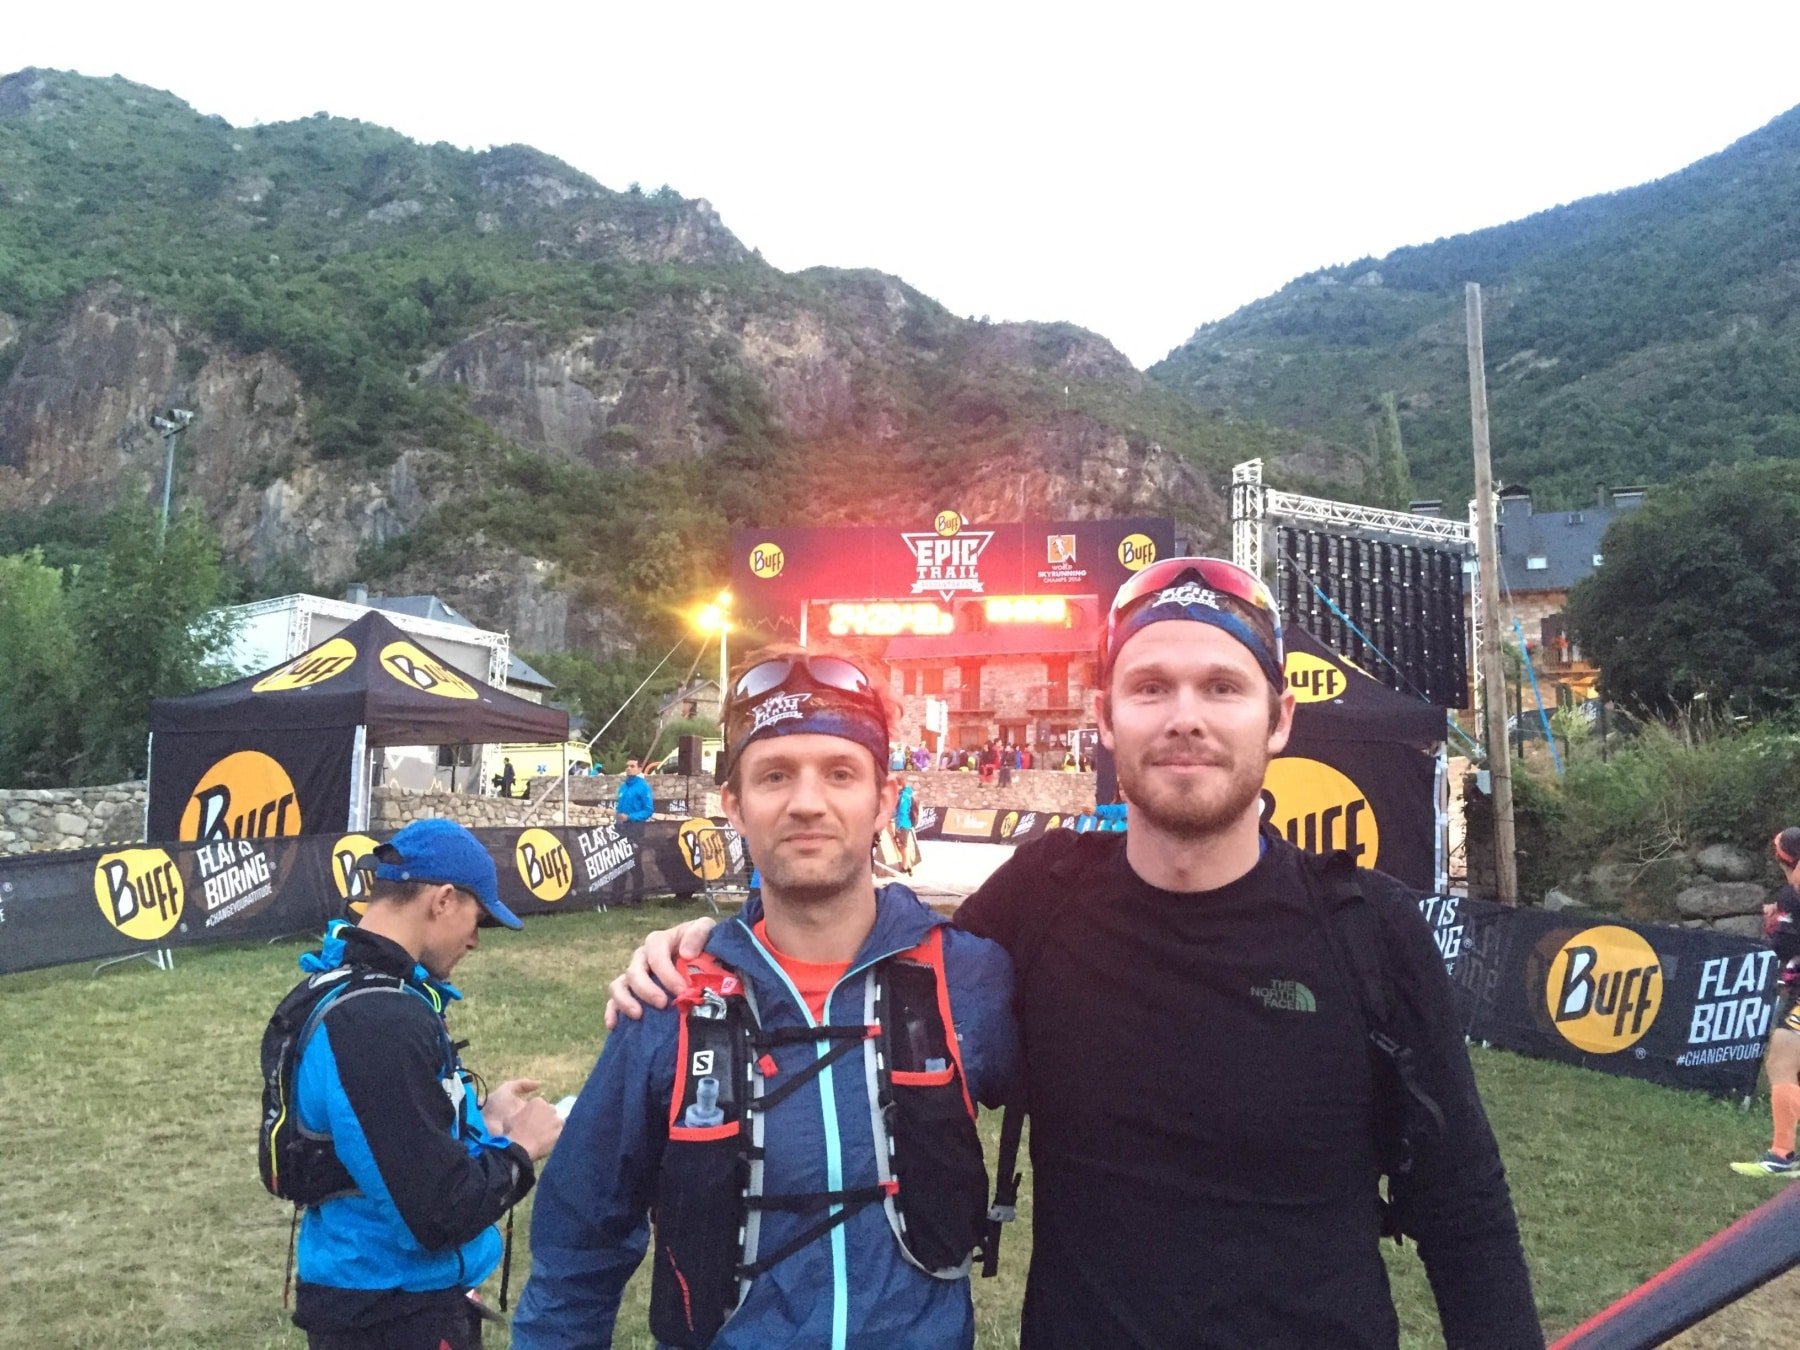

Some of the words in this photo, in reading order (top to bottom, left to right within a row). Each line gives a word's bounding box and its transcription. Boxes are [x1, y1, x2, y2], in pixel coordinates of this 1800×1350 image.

[753, 550, 781, 572] BUFF
[915, 539, 980, 567] EPIC
[1122, 541, 1153, 565] BUFF
[916, 566, 979, 579] TRAIL
[1037, 569, 1087, 578] SKYRUNNING
[1284, 668, 1339, 696] UFF
[518, 842, 569, 890] BUFF
[585, 837, 633, 880] BORING
[99, 858, 179, 927] BUFF
[203, 852, 271, 911] BORING
[1438, 897, 1460, 926] IS
[1271, 979, 1295, 990] THE
[1698, 950, 1777, 1000] FLAT
[1250, 985, 1295, 1001] NORTH
[1264, 998, 1296, 1010] FACE
[1555, 945, 1659, 1037] BUFF
